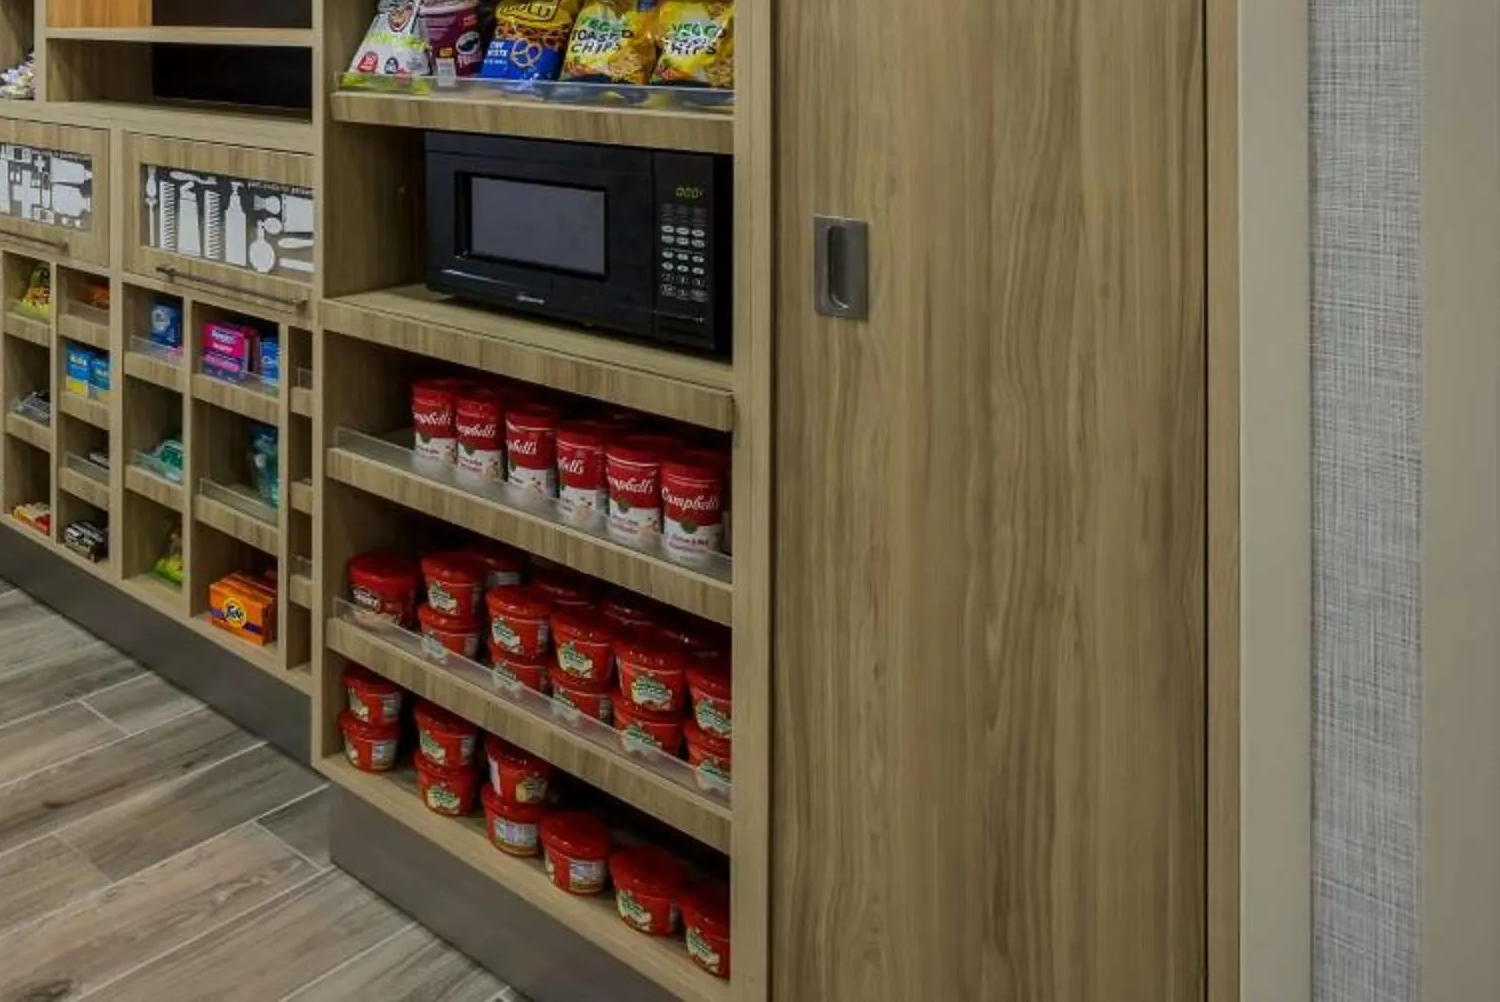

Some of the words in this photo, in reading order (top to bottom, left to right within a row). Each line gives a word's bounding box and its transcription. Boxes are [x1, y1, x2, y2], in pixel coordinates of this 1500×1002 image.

[457, 422, 497, 438] mpbell's
[607, 466, 653, 494] mpbell's
[661, 486, 719, 510] Campbell's
